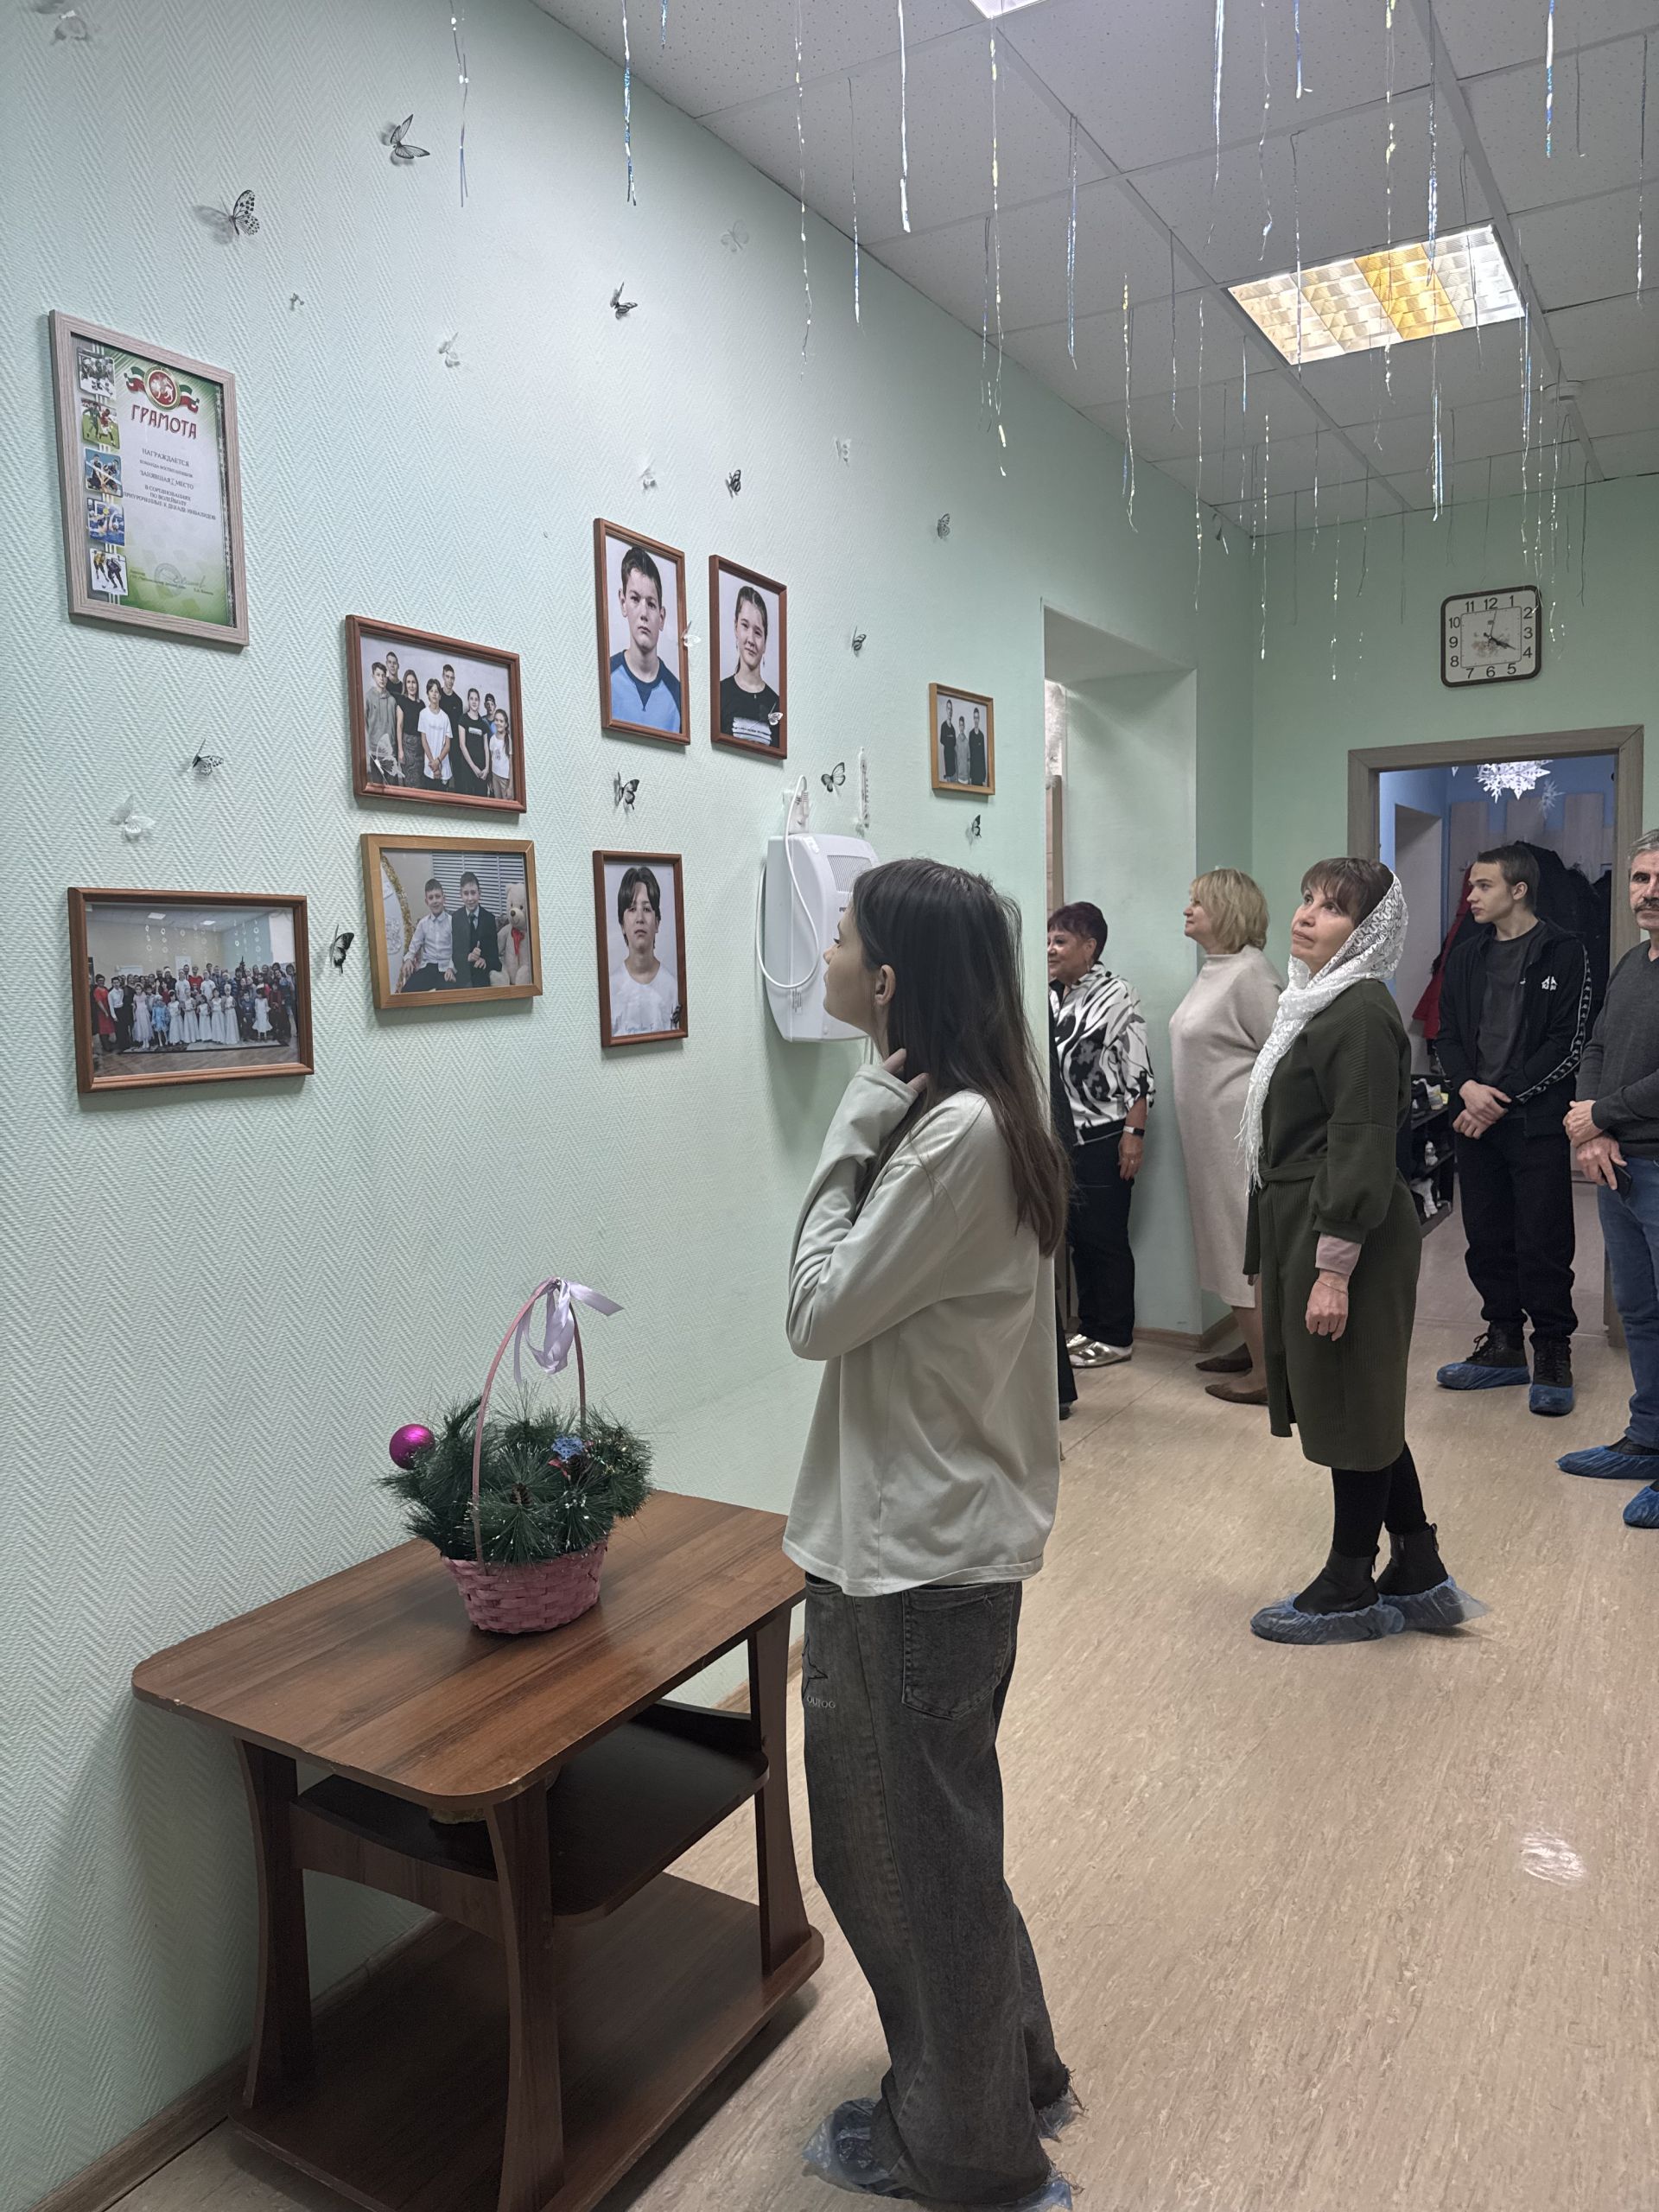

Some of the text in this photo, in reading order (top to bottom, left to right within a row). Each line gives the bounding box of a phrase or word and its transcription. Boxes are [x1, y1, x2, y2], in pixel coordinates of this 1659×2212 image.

[131, 404, 197, 440] ГРАМОТА
[142, 448, 189, 467] НАГРАЖДАЕТСЯ
[175, 480, 194, 490] МЕСТО
[1465, 601, 1474, 613] 11
[1484, 597, 1497, 610] 12
[1510, 595, 1514, 607] 1
[1523, 607, 1533, 620] 2
[1449, 616, 1460, 628] 10
[1523, 627, 1533, 639] 3
[1449, 636, 1459, 648] 9
[1522, 646, 1533, 658] 4
[1450, 656, 1459, 667] 8
[1465, 668, 1474, 679] 7
[1486, 666, 1496, 677] 6
[1507, 663, 1516, 675] 5
